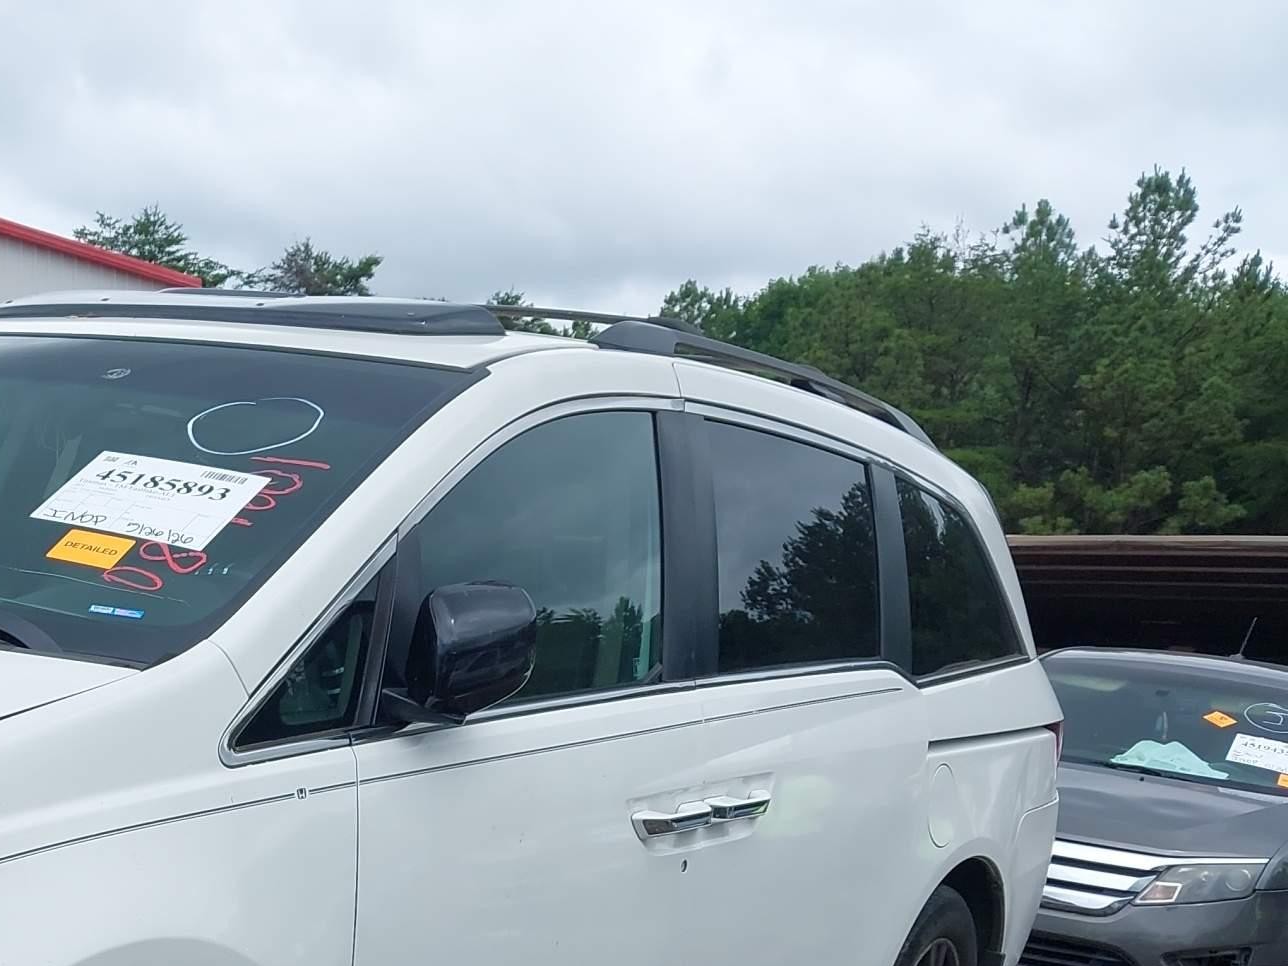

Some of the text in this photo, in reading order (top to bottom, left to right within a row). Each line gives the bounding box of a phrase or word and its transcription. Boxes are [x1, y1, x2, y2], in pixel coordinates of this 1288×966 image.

[96, 469, 231, 501] 45185893
[43, 508, 107, 526] INOP
[64, 540, 118, 556] DETAILED
